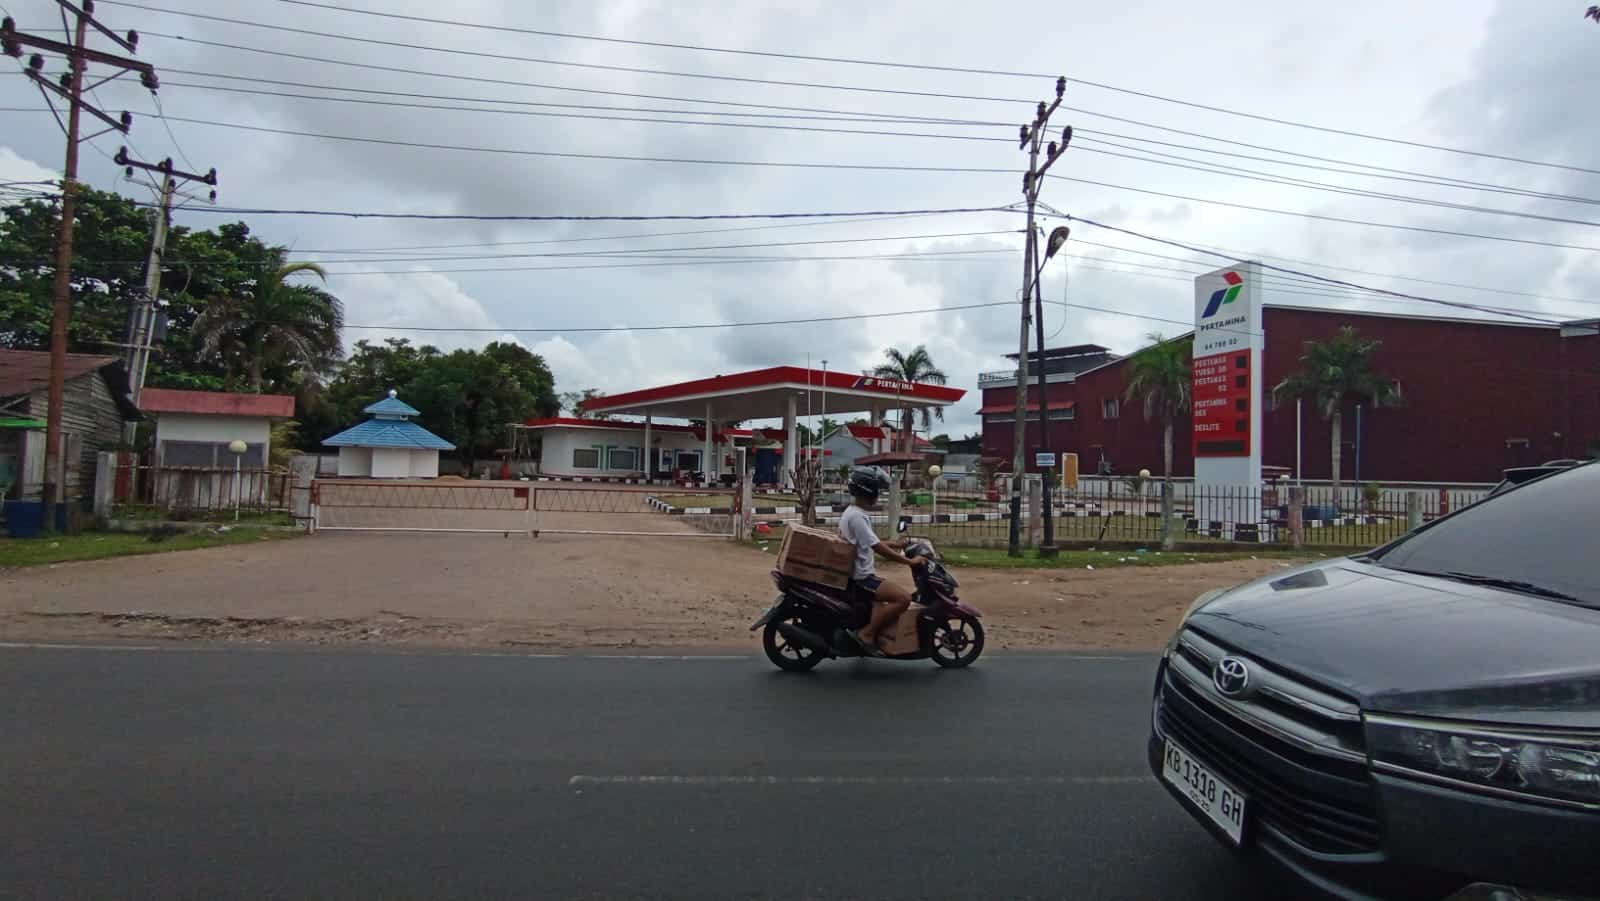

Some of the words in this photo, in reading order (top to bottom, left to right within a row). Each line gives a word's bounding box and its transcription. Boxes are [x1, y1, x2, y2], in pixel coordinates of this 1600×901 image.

[1200, 315, 1246, 331] PERTAMINA
[1166, 744, 1180, 773] KB
[1183, 760, 1216, 803] 1318
[1222, 790, 1241, 827] GH
